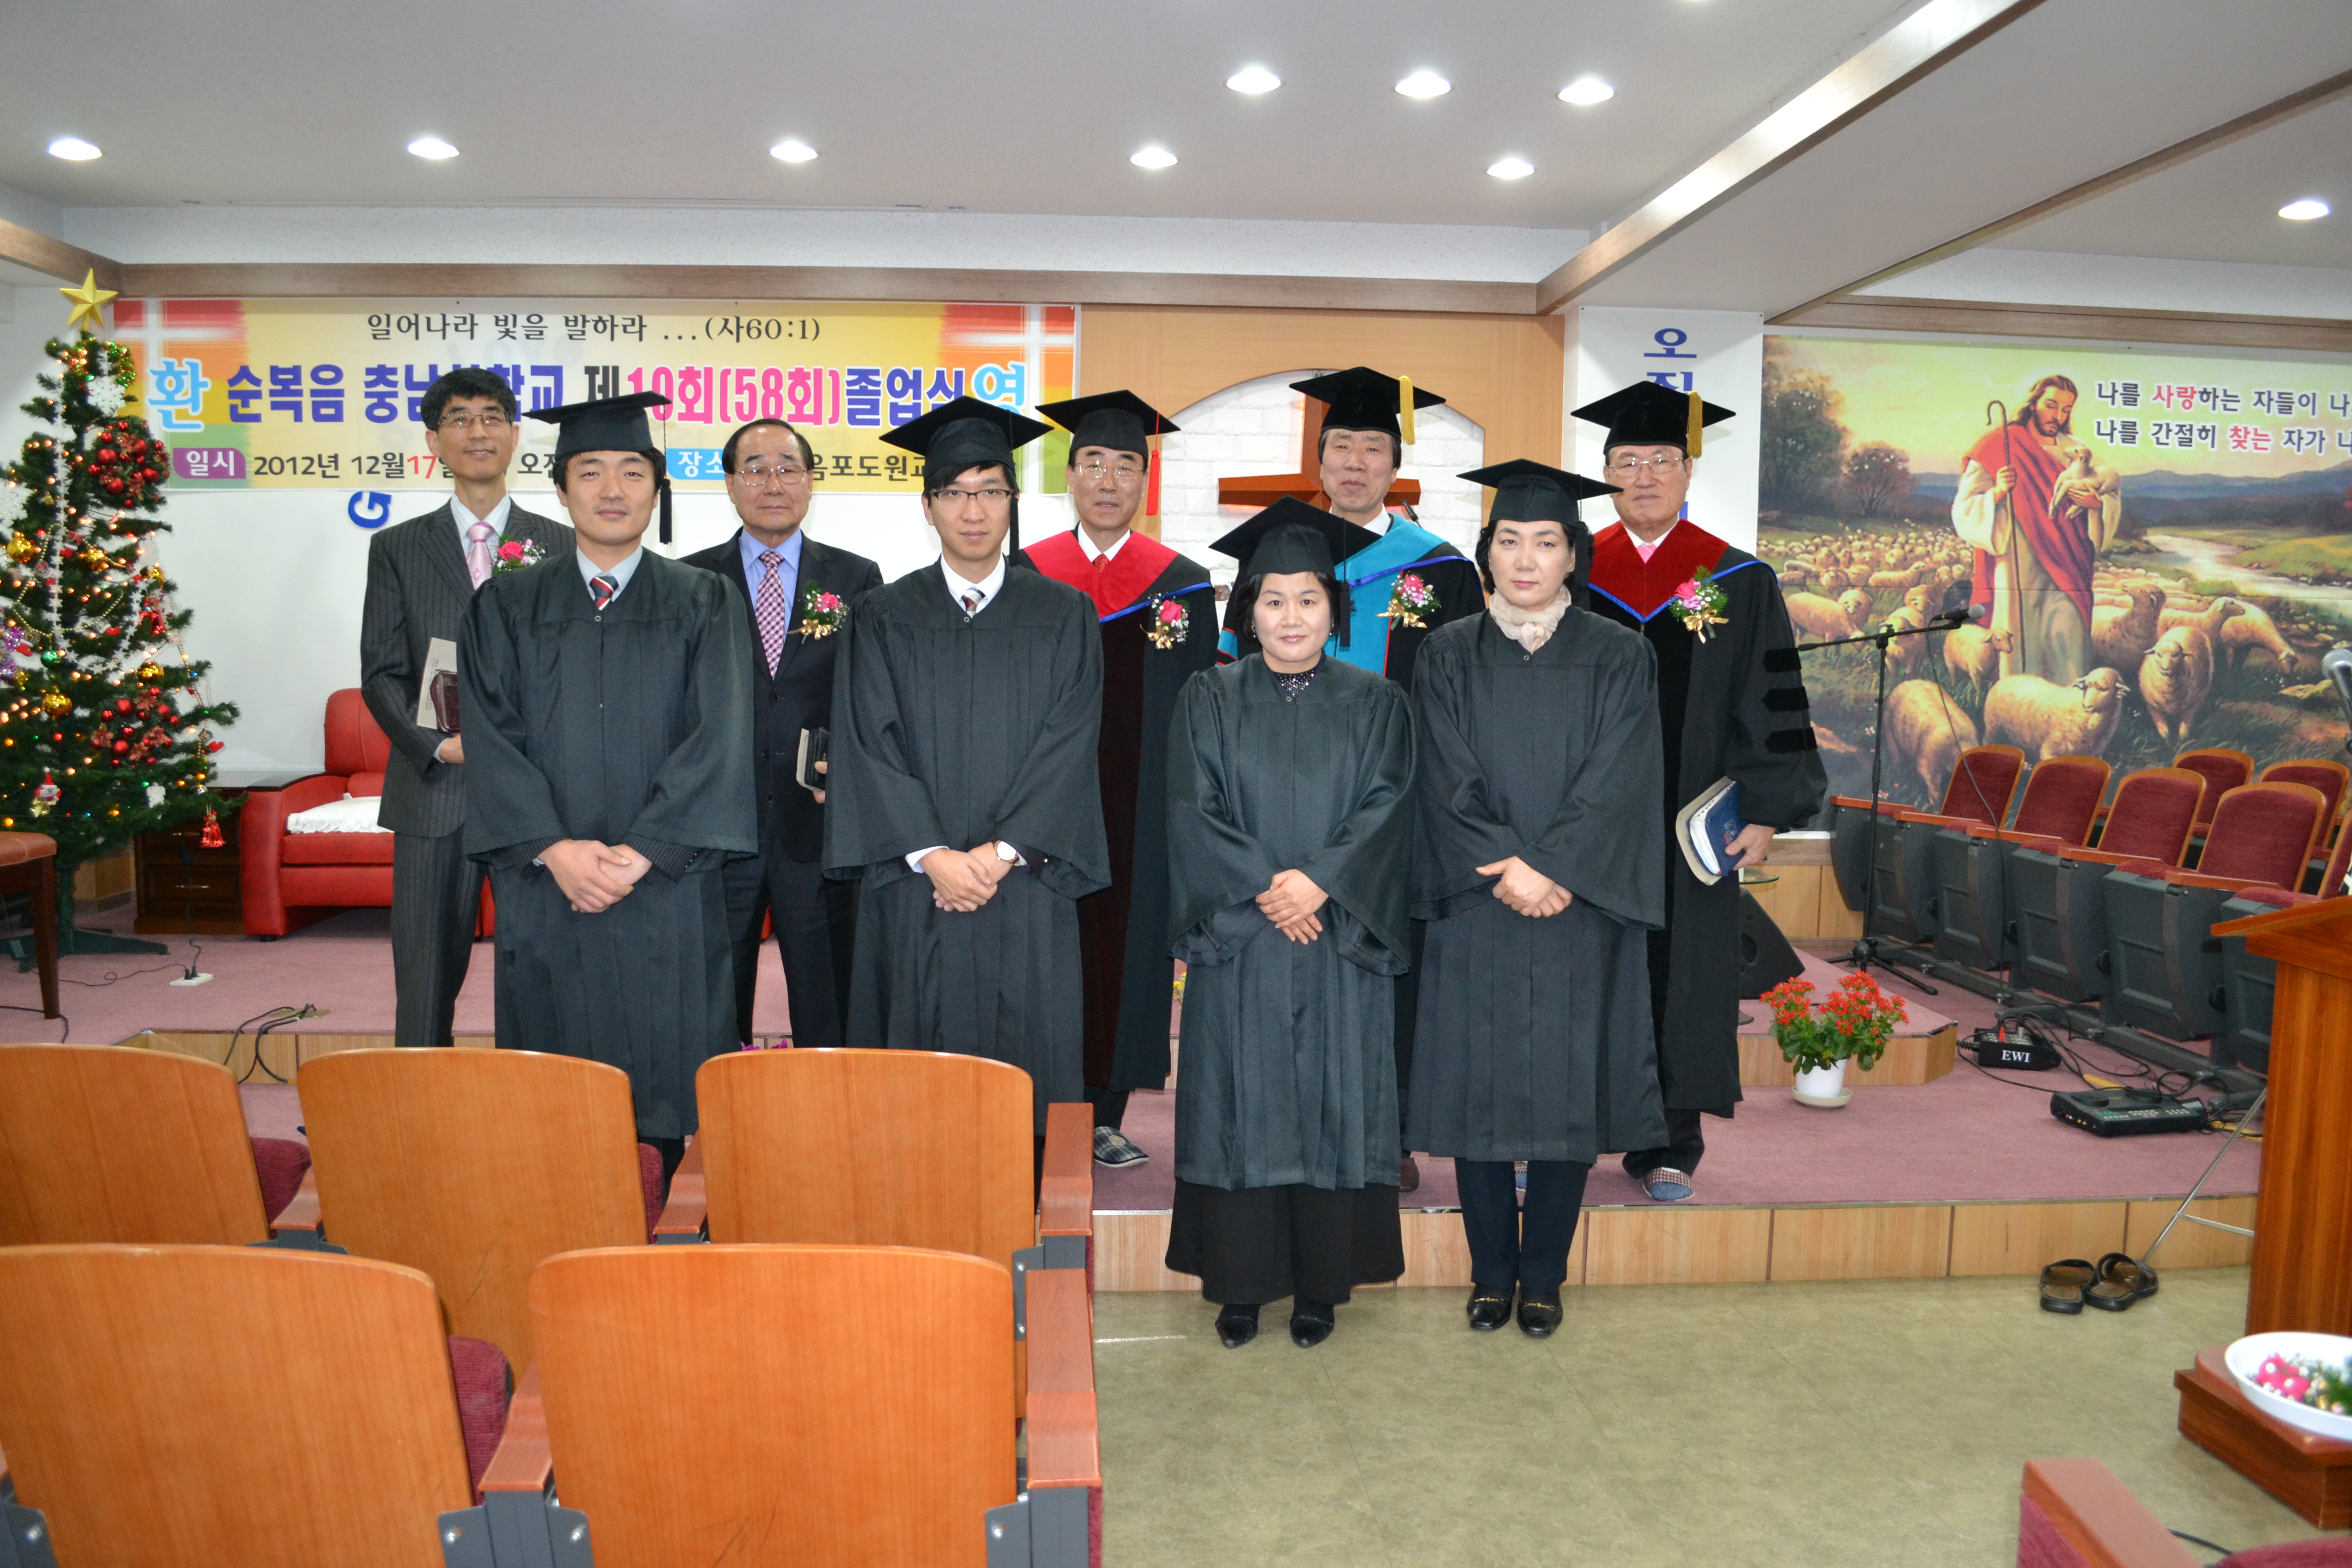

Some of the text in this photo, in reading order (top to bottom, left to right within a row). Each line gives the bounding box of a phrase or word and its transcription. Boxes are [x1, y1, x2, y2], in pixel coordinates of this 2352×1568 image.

[367, 314, 479, 341] 일어나라
[494, 314, 548, 341] 빛을
[566, 314, 647, 342] 발하라
[149, 359, 209, 430] 환
[227, 364, 345, 423] 순복음
[974, 363, 1025, 415] 영
[2097, 382, 2352, 417] 나를 사랑하는 자들이 나
[2096, 420, 2139, 445] 나를
[2151, 422, 2216, 449] 간절히
[2229, 426, 2271, 451] 찾는
[2283, 429, 2325, 454] 자가
[186, 450, 235, 478] 일시
[254, 452, 340, 479] 2012년
[677, 451, 725, 478] 장소
[348, 491, 392, 529] G
[2002, 1050, 2030, 1063] EWI
